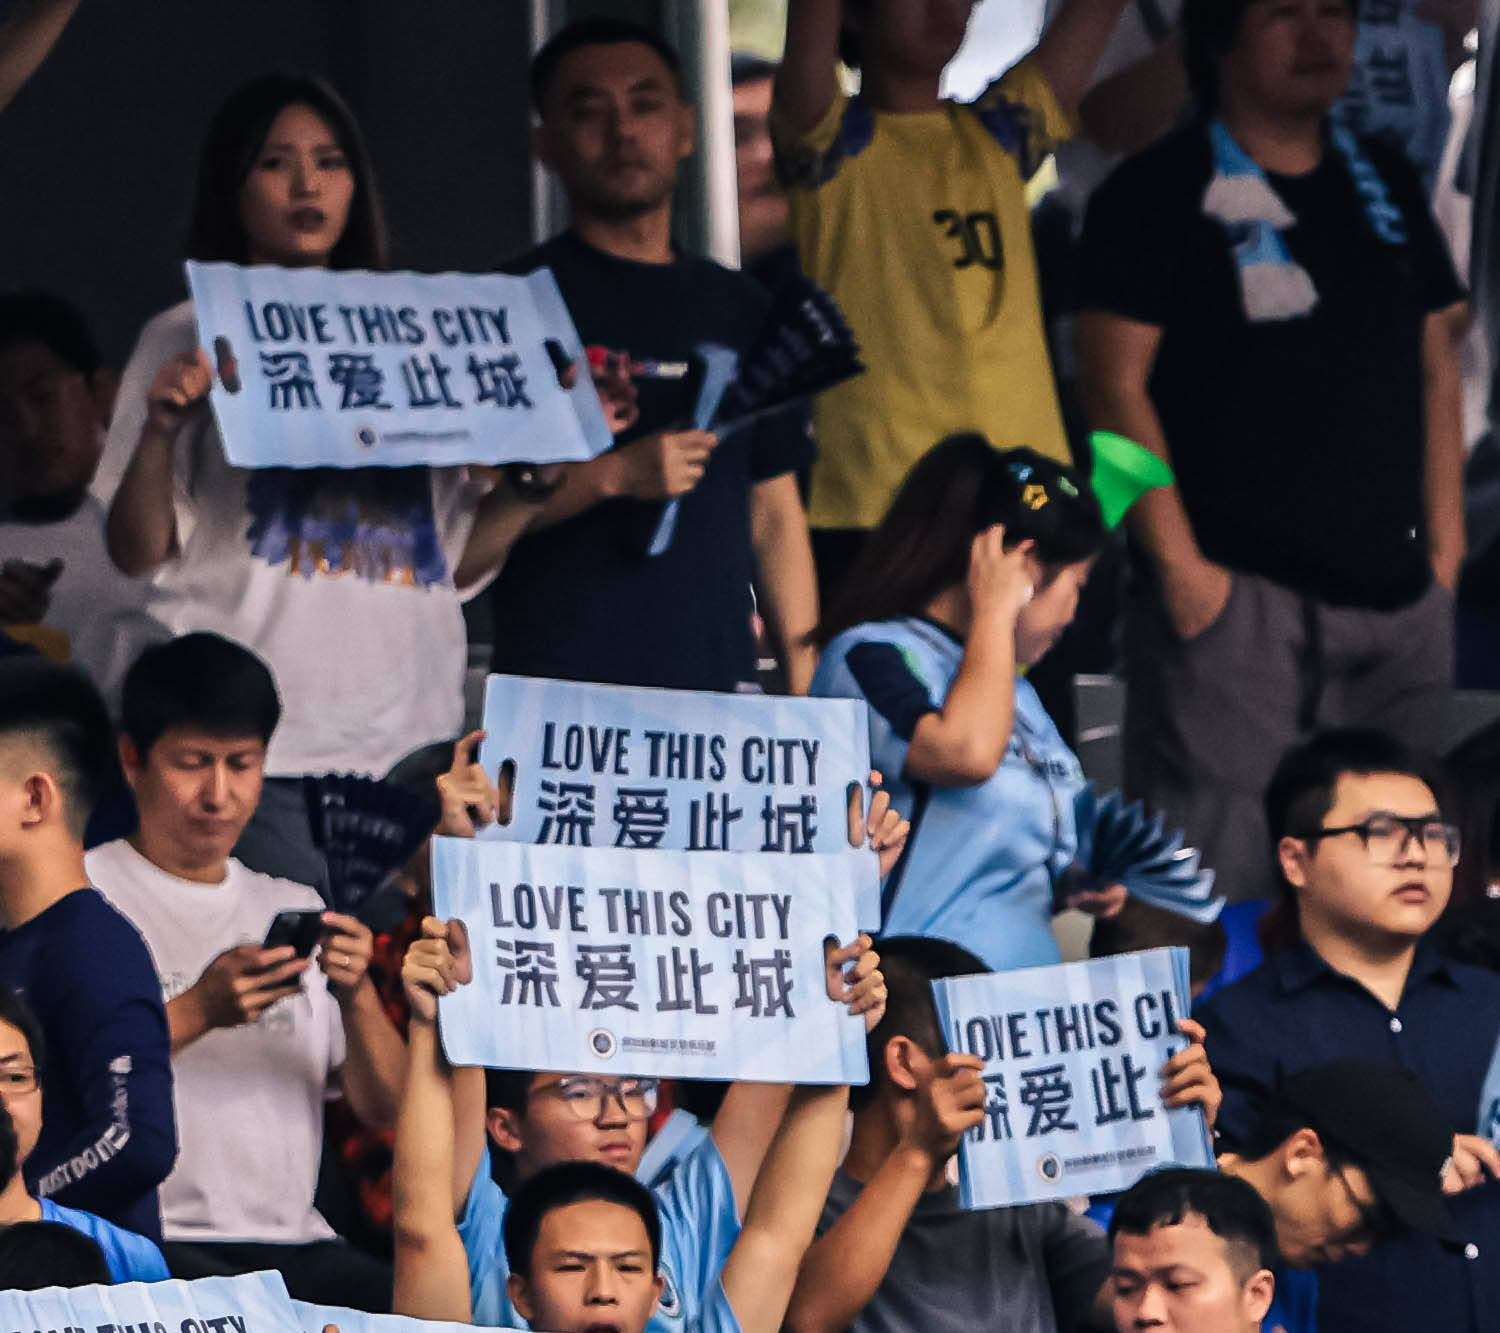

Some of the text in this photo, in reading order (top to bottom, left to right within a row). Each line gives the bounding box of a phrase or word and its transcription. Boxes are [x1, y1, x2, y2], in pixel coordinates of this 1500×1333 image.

[933, 209, 1003, 270] 30
[244, 300, 510, 347] LOVE THIS CITY
[259, 351, 535, 410] 深爱此城
[542, 722, 820, 786] LOVE THIS CITY
[533, 779, 817, 854] 深爱此城
[490, 883, 792, 940] LOVE THIS CITY
[496, 939, 796, 1019] 深爱此城
